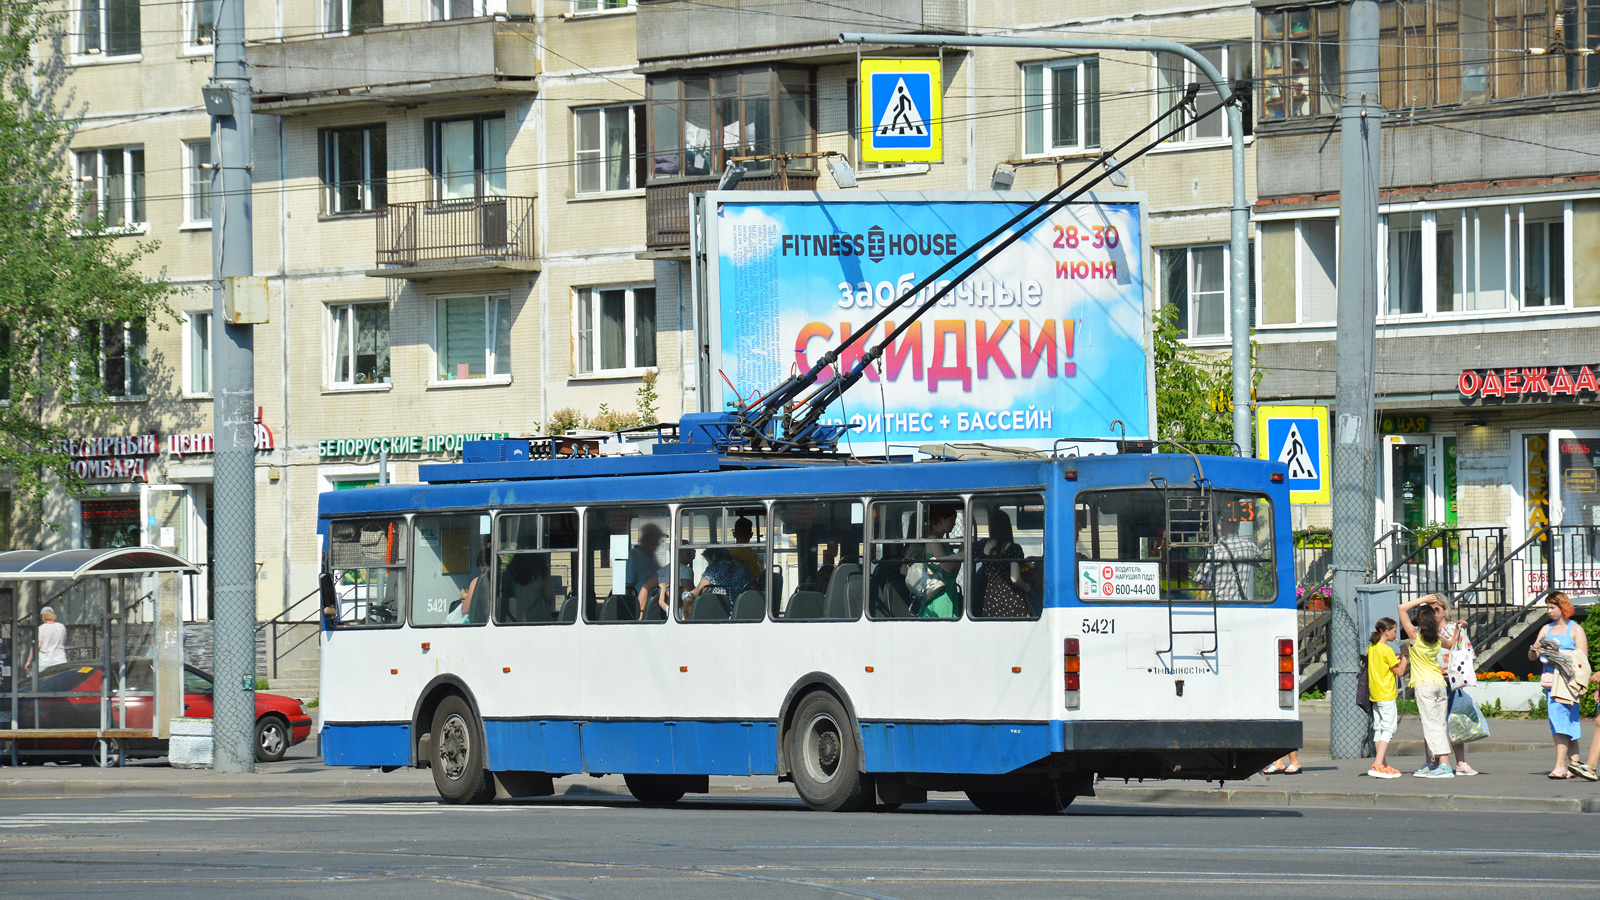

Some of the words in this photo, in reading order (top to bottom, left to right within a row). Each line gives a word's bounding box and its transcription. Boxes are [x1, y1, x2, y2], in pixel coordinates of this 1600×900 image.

[782, 234, 865, 256] FITNESS
[889, 234, 957, 255] HOUSE
[1053, 225, 1119, 249] 28-30
[837, 272, 1042, 308] заоблачные
[795, 319, 1077, 391] СКИДКИ!
[1458, 365, 1600, 398] ОДЕЖДА
[850, 411, 933, 434] ФИТНЕС
[958, 405, 1052, 431] БАССЕЙН
[318, 436, 418, 456] БЕЛОРУССКИЕ
[1561, 444, 1590, 454] ОБУВЬ
[1528, 438, 1549, 541] ОДЕЖДА
[1228, 501, 1254, 522] 13
[1116, 584, 1156, 594] 600-44-00
[428, 599, 446, 612] 5421
[1082, 619, 1114, 634] 5421
